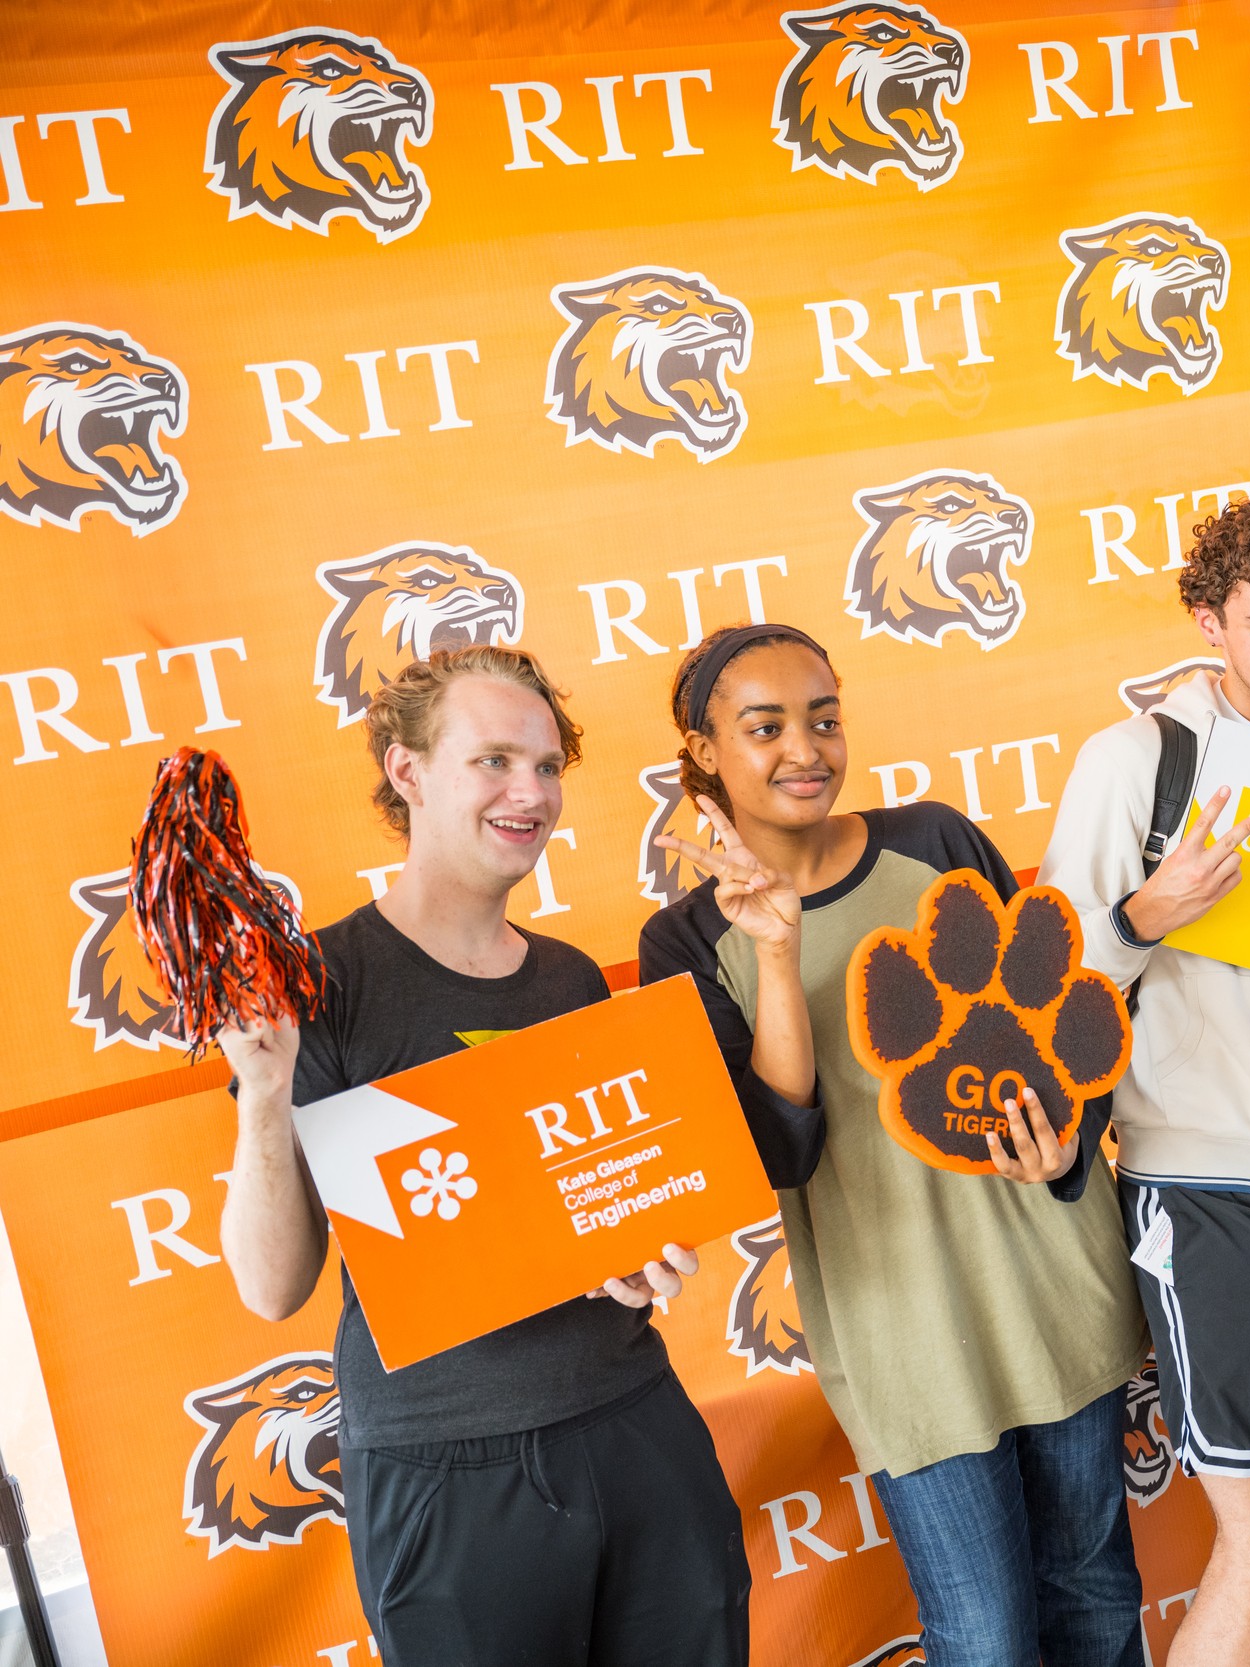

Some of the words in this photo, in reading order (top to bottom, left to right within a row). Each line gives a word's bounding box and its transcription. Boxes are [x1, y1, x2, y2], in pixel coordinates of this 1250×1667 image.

[490, 69, 713, 171] RIT
[1018, 29, 1199, 124] RIT
[0, 108, 132, 212] IT
[803, 281, 1001, 385] RIT
[244, 339, 481, 452] RIT
[576, 554, 789, 666] RIT
[0, 636, 248, 766] RIT
[524, 1068, 651, 1160] RIT
[942, 1111, 1013, 1139] TIGER
[945, 1064, 1028, 1114] GO
[556, 1168, 597, 1195] Kate
[596, 1144, 663, 1178] Gleason
[564, 1178, 623, 1211] College
[623, 1170, 640, 1188] of
[570, 1169, 707, 1237] Engineering
[759, 1472, 890, 1579] RI
